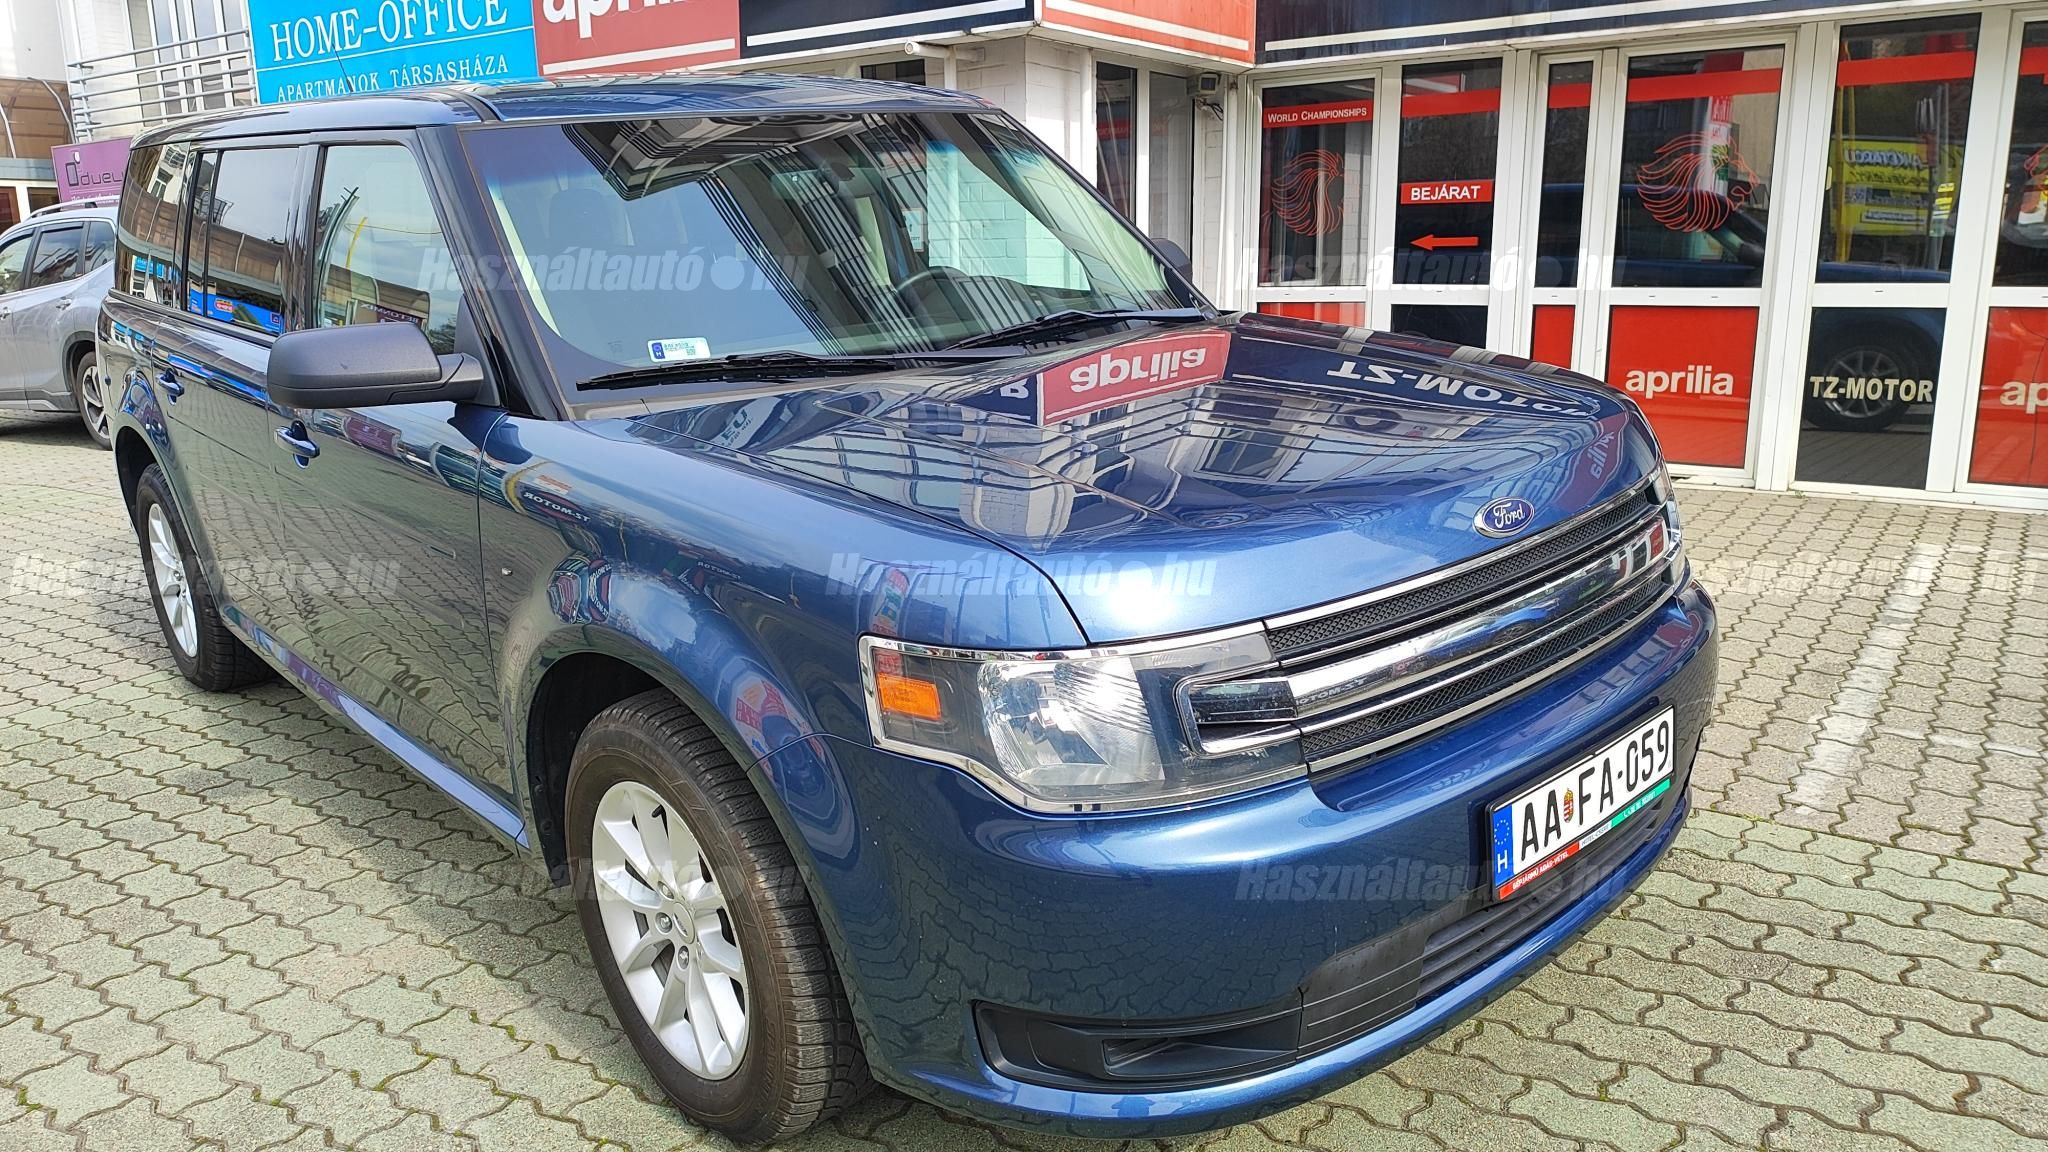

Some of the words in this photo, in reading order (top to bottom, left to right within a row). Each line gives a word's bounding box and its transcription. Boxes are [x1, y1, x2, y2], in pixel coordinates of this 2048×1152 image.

[270, 0, 508, 61] HOME-OFFICE
[390, 54, 509, 87] TÁRSASHÁZA
[1410, 184, 1481, 201] BEJÁRAT
[1624, 364, 1734, 398] aprilia
[1809, 376, 1933, 403] TZ-MOTOR
[1493, 502, 1526, 528] Ford
[1497, 849, 1508, 873] H
[1521, 789, 1562, 862] AA
